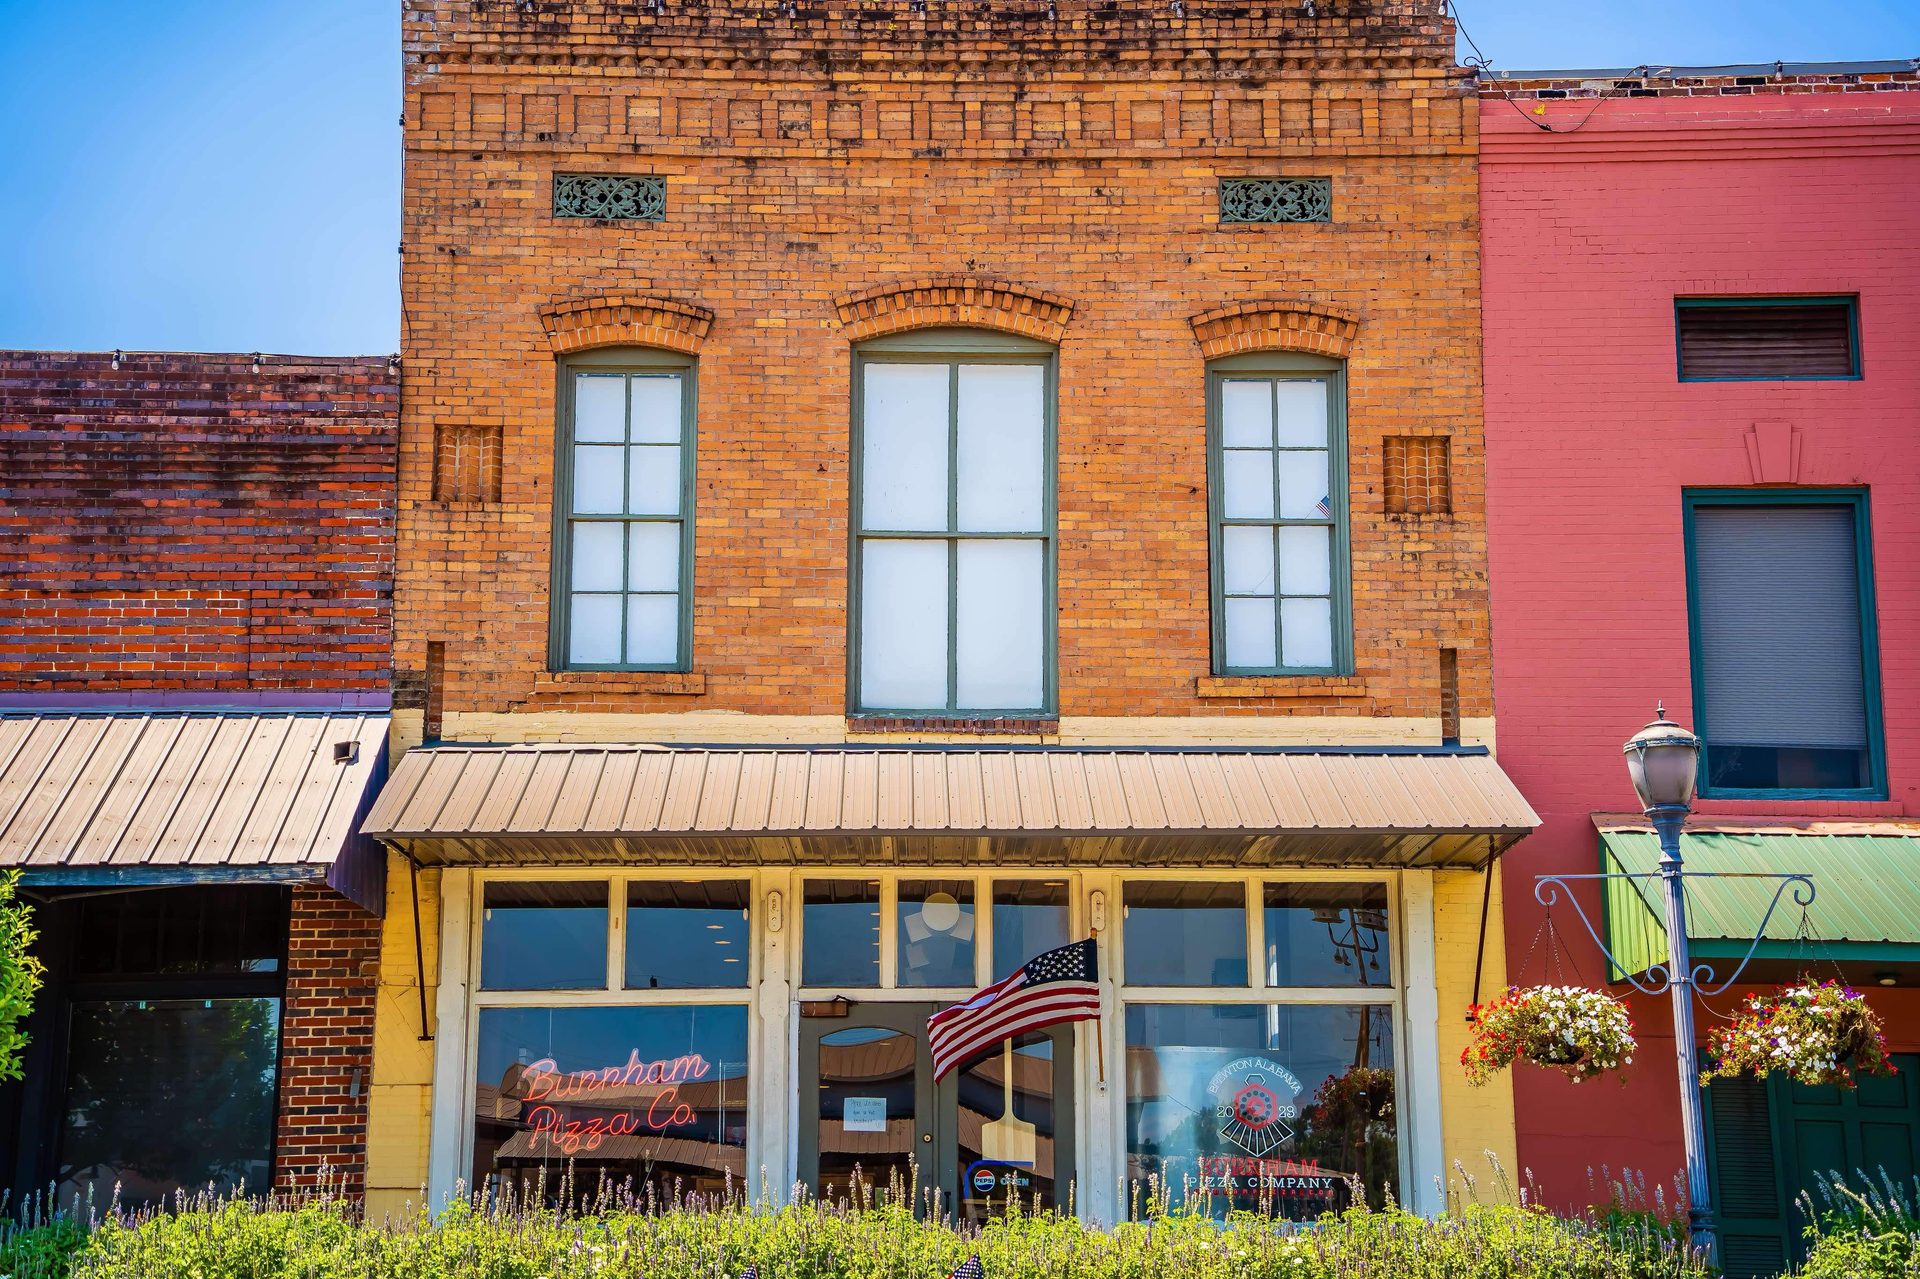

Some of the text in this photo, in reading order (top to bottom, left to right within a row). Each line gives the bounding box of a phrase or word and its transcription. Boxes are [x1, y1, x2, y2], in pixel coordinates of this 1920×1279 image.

[1209, 1059, 1301, 1095] BREWTON ALABAMA
[1216, 1105, 1295, 1118] 20 23
[528, 1106, 639, 1154] Pizza
[1198, 1157, 1319, 1176] BURNHAM
[1188, 1177, 1332, 1188] PZZA COMPANY
